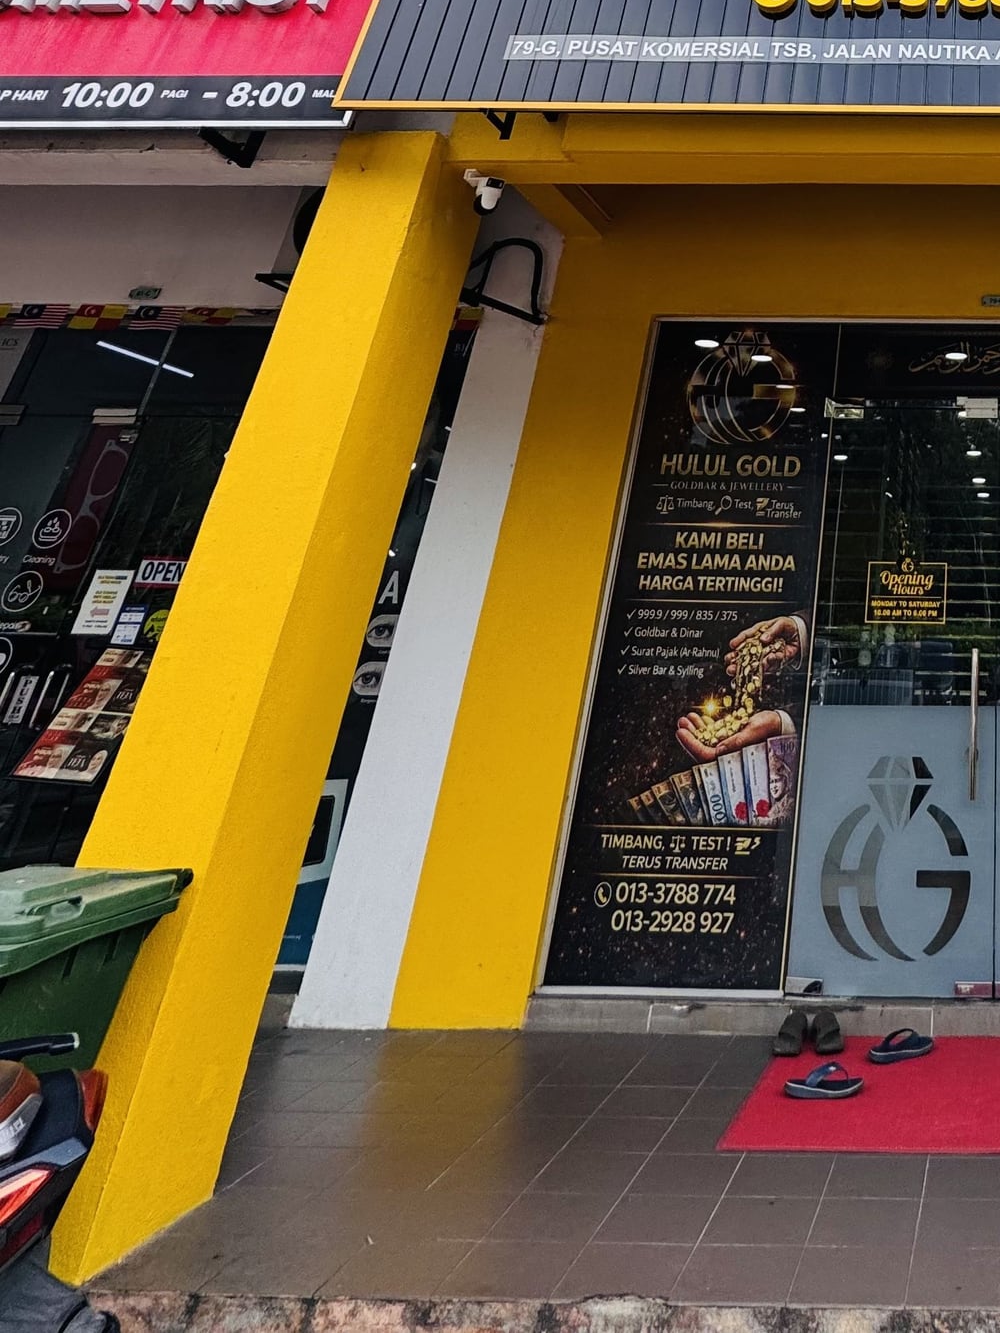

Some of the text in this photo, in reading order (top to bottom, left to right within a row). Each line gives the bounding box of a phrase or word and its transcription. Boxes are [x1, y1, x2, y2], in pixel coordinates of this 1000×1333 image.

[512, 39, 562, 60] 79-G,
[567, 40, 637, 58] PUSAT
[642, 41, 765, 59] KOMERSIAL
[771, 42, 818, 61] TSB,
[823, 43, 892, 60] JALAN
[899, 44, 990, 61] NAUTIKA
[13, 89, 49, 100] HARI
[61, 81, 154, 108] 10:00
[160, 89, 189, 99] PAGI
[226, 82, 306, 108] 8:00
[312, 89, 336, 99] MAL
[660, 453, 801, 477] HULUL GOLD
[728, 481, 785, 492] JEWELLERY
[677, 497, 716, 511] Timbang,
[771, 500, 795, 511] Terus
[675, 531, 764, 550] KAMI BELI
[637, 552, 796, 571] EMAS LAMA ANDA
[141, 561, 188, 582] OPEN
[880, 570, 934, 591] Opening
[639, 574, 784, 593] HARGA TERTINGGI!
[892, 583, 924, 595] Hours
[670, 609, 688, 620] 999
[634, 627, 669, 638] Goldbar
[679, 627, 704, 638] Dinar
[631, 646, 720, 660] Surat Pajak (Ar-Rahnu)
[628, 665, 651, 675] Silver
[652, 665, 667, 675] Bar
[601, 834, 665, 851] TIMBANG,
[691, 836, 724, 850] TEST
[622, 855, 729, 871] TERUS TRANSFER
[615, 881, 736, 905] 013-3788 774
[611, 909, 735, 934] 013-2928 927
